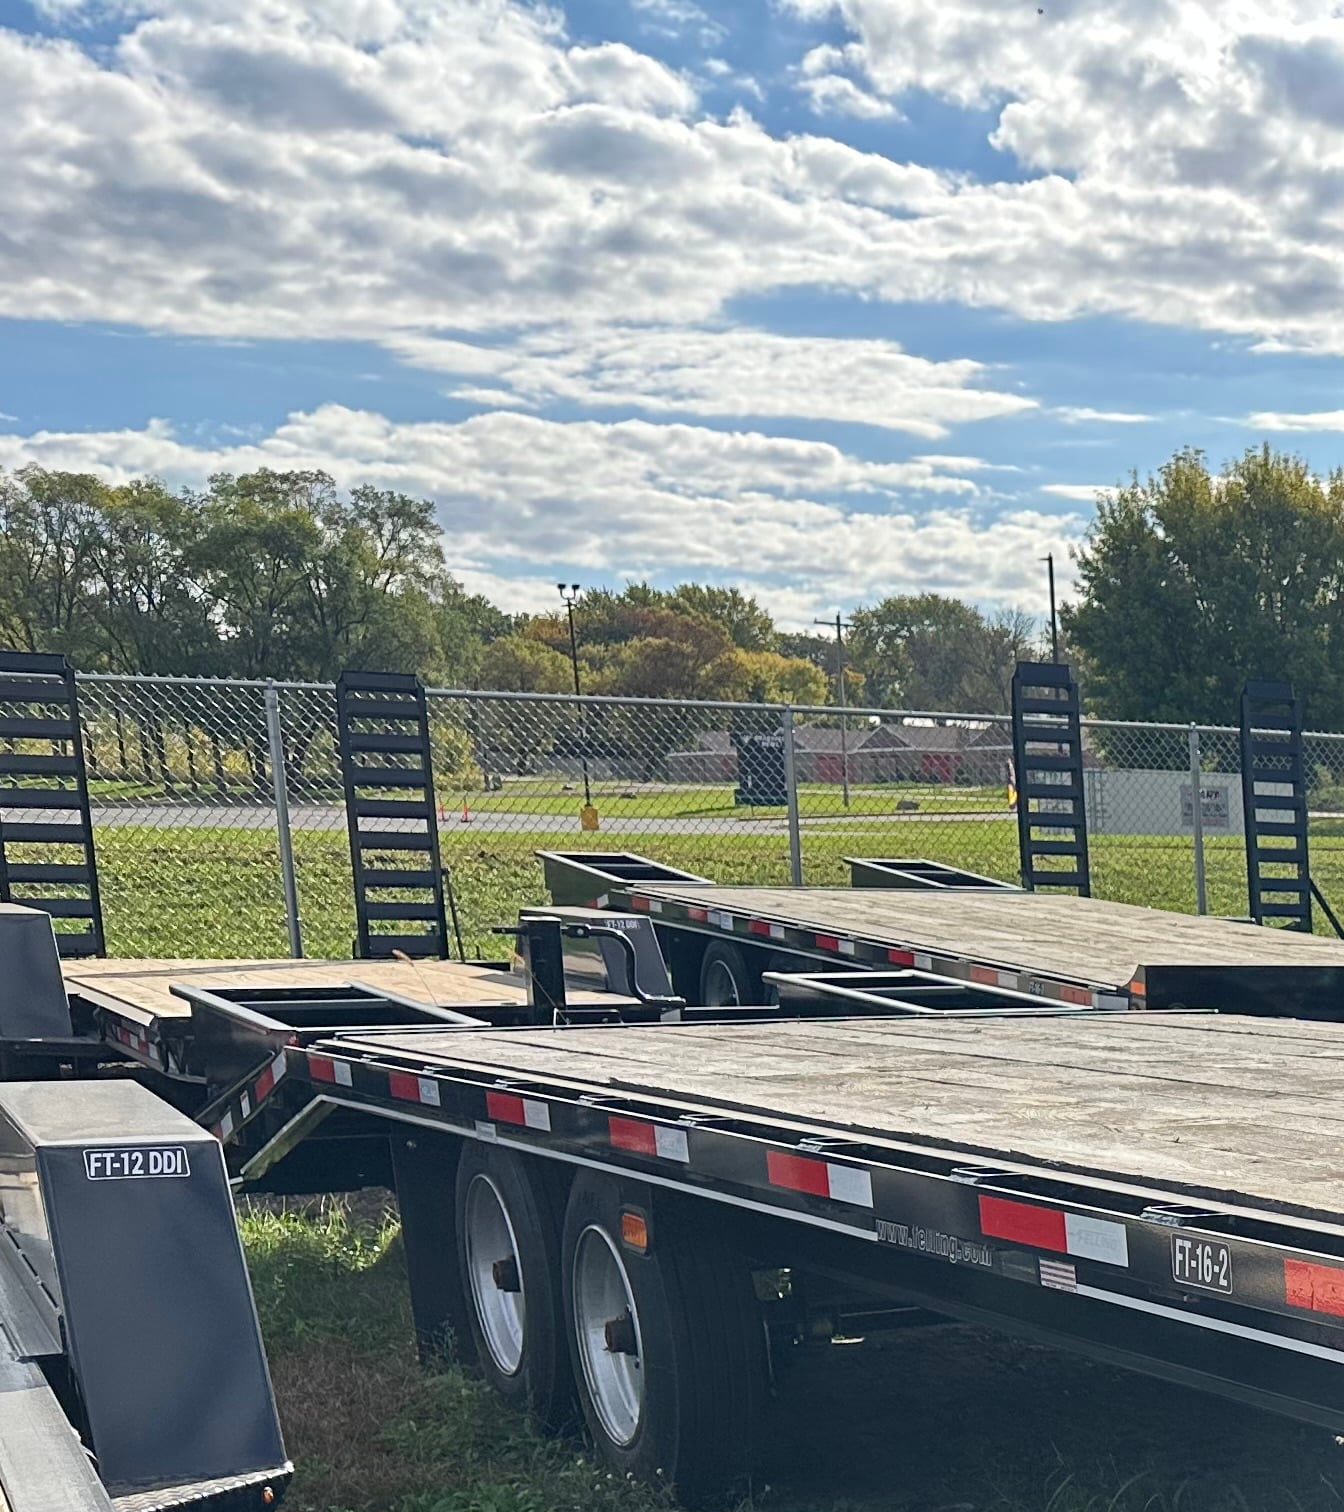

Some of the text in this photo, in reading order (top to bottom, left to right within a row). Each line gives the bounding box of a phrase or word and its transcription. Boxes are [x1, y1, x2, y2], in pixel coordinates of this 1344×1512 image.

[89, 1150, 182, 1177] FT-12 DDI
[876, 1218, 993, 1268] www.felling.com
[1175, 1238, 1228, 1287] FT-16-2
